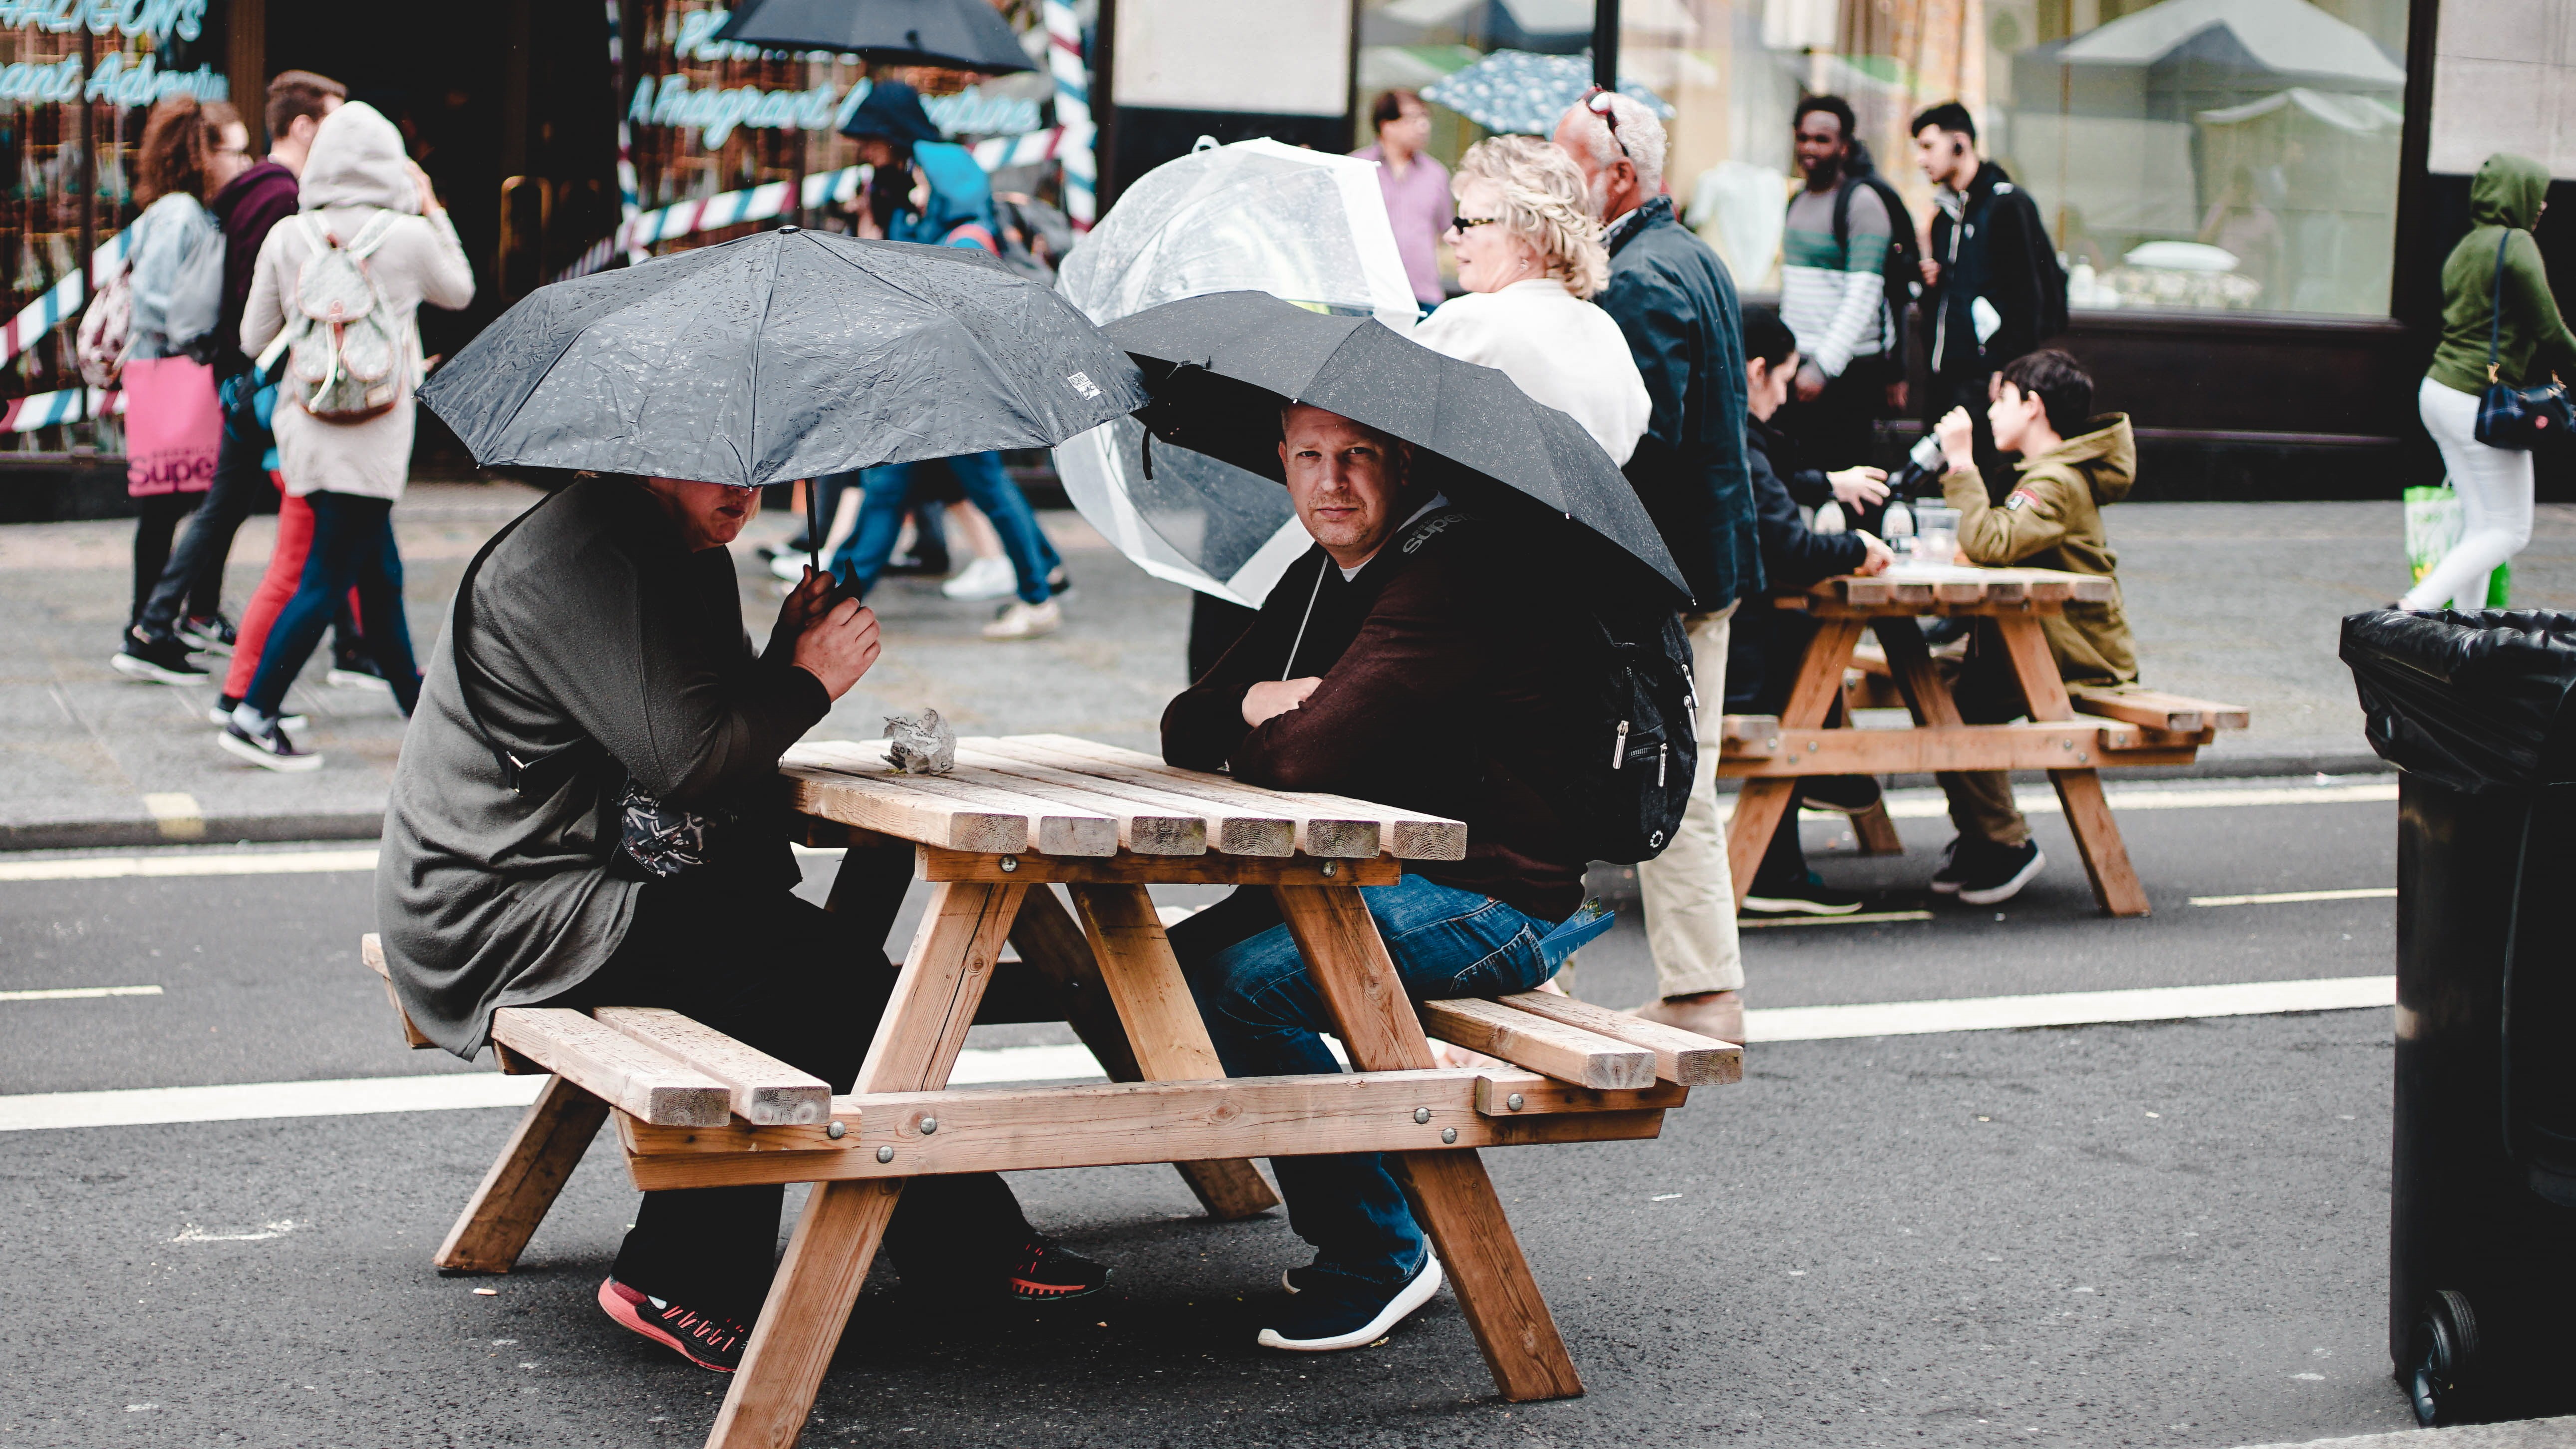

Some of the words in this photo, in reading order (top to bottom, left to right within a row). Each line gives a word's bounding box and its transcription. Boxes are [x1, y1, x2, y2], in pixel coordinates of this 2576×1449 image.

[0, 52, 84, 104] ant
[628, 73, 655, 126] A
[651, 73, 835, 151] Fragrant
[1402, 512, 1481, 555] Super
